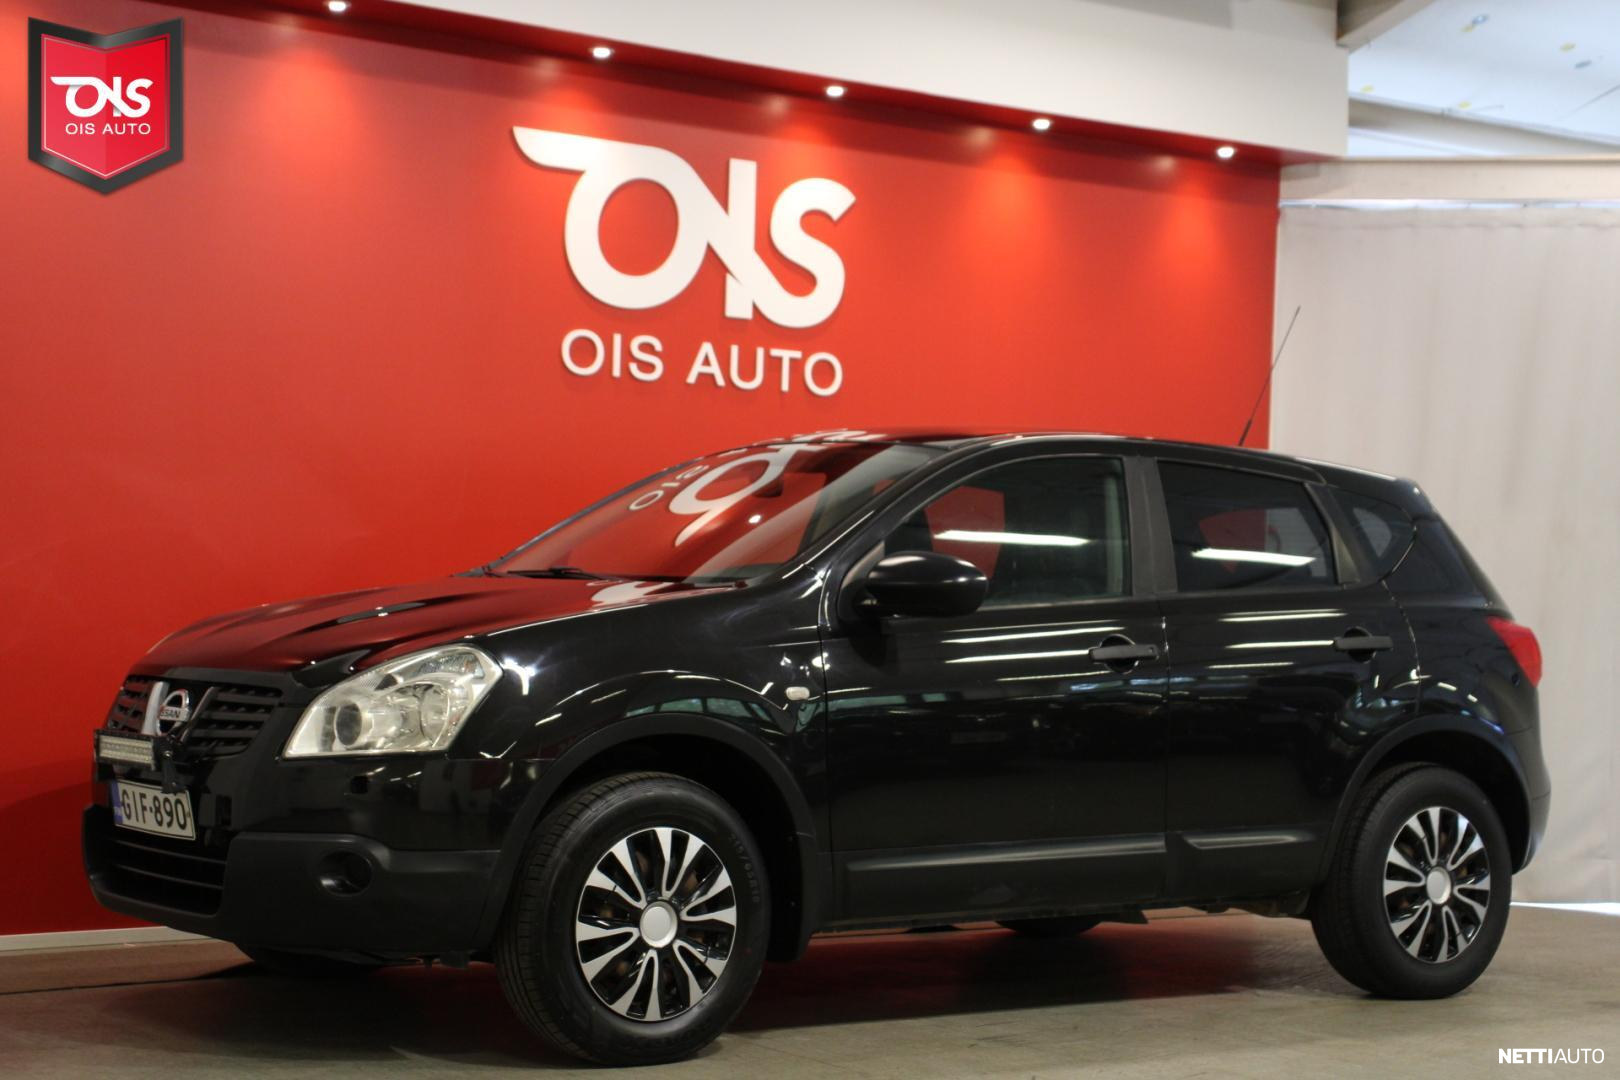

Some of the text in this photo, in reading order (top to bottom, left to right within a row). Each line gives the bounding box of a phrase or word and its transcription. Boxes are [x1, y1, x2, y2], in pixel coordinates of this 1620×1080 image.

[560, 328, 844, 397] OIS AUTO
[121, 789, 188, 830] GIF-890
